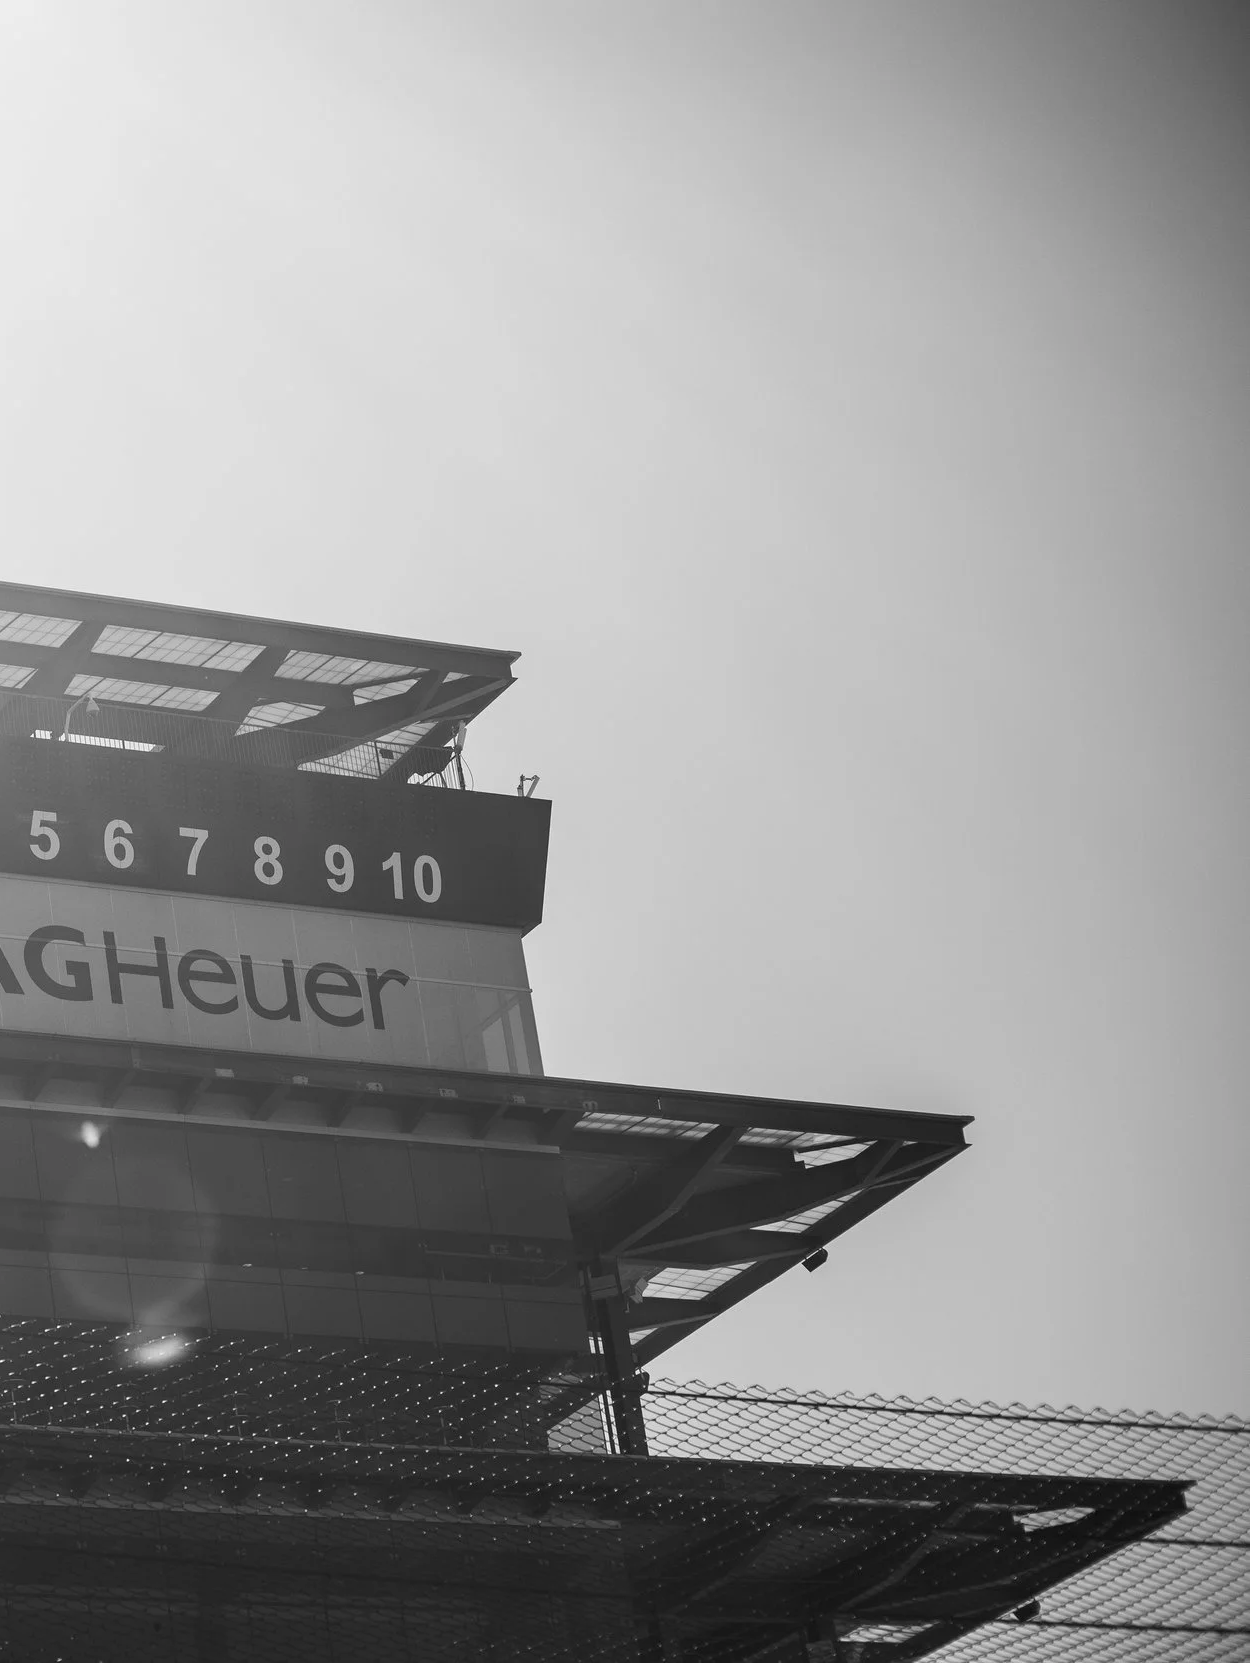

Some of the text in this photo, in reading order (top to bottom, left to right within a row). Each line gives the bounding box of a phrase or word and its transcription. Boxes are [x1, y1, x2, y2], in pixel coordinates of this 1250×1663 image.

[29, 810, 60, 860] 5
[103, 819, 135, 869] 6
[179, 827, 208, 876] 7
[253, 836, 283, 885] 8
[324, 844, 354, 893] 9
[382, 851, 442, 903] 10
